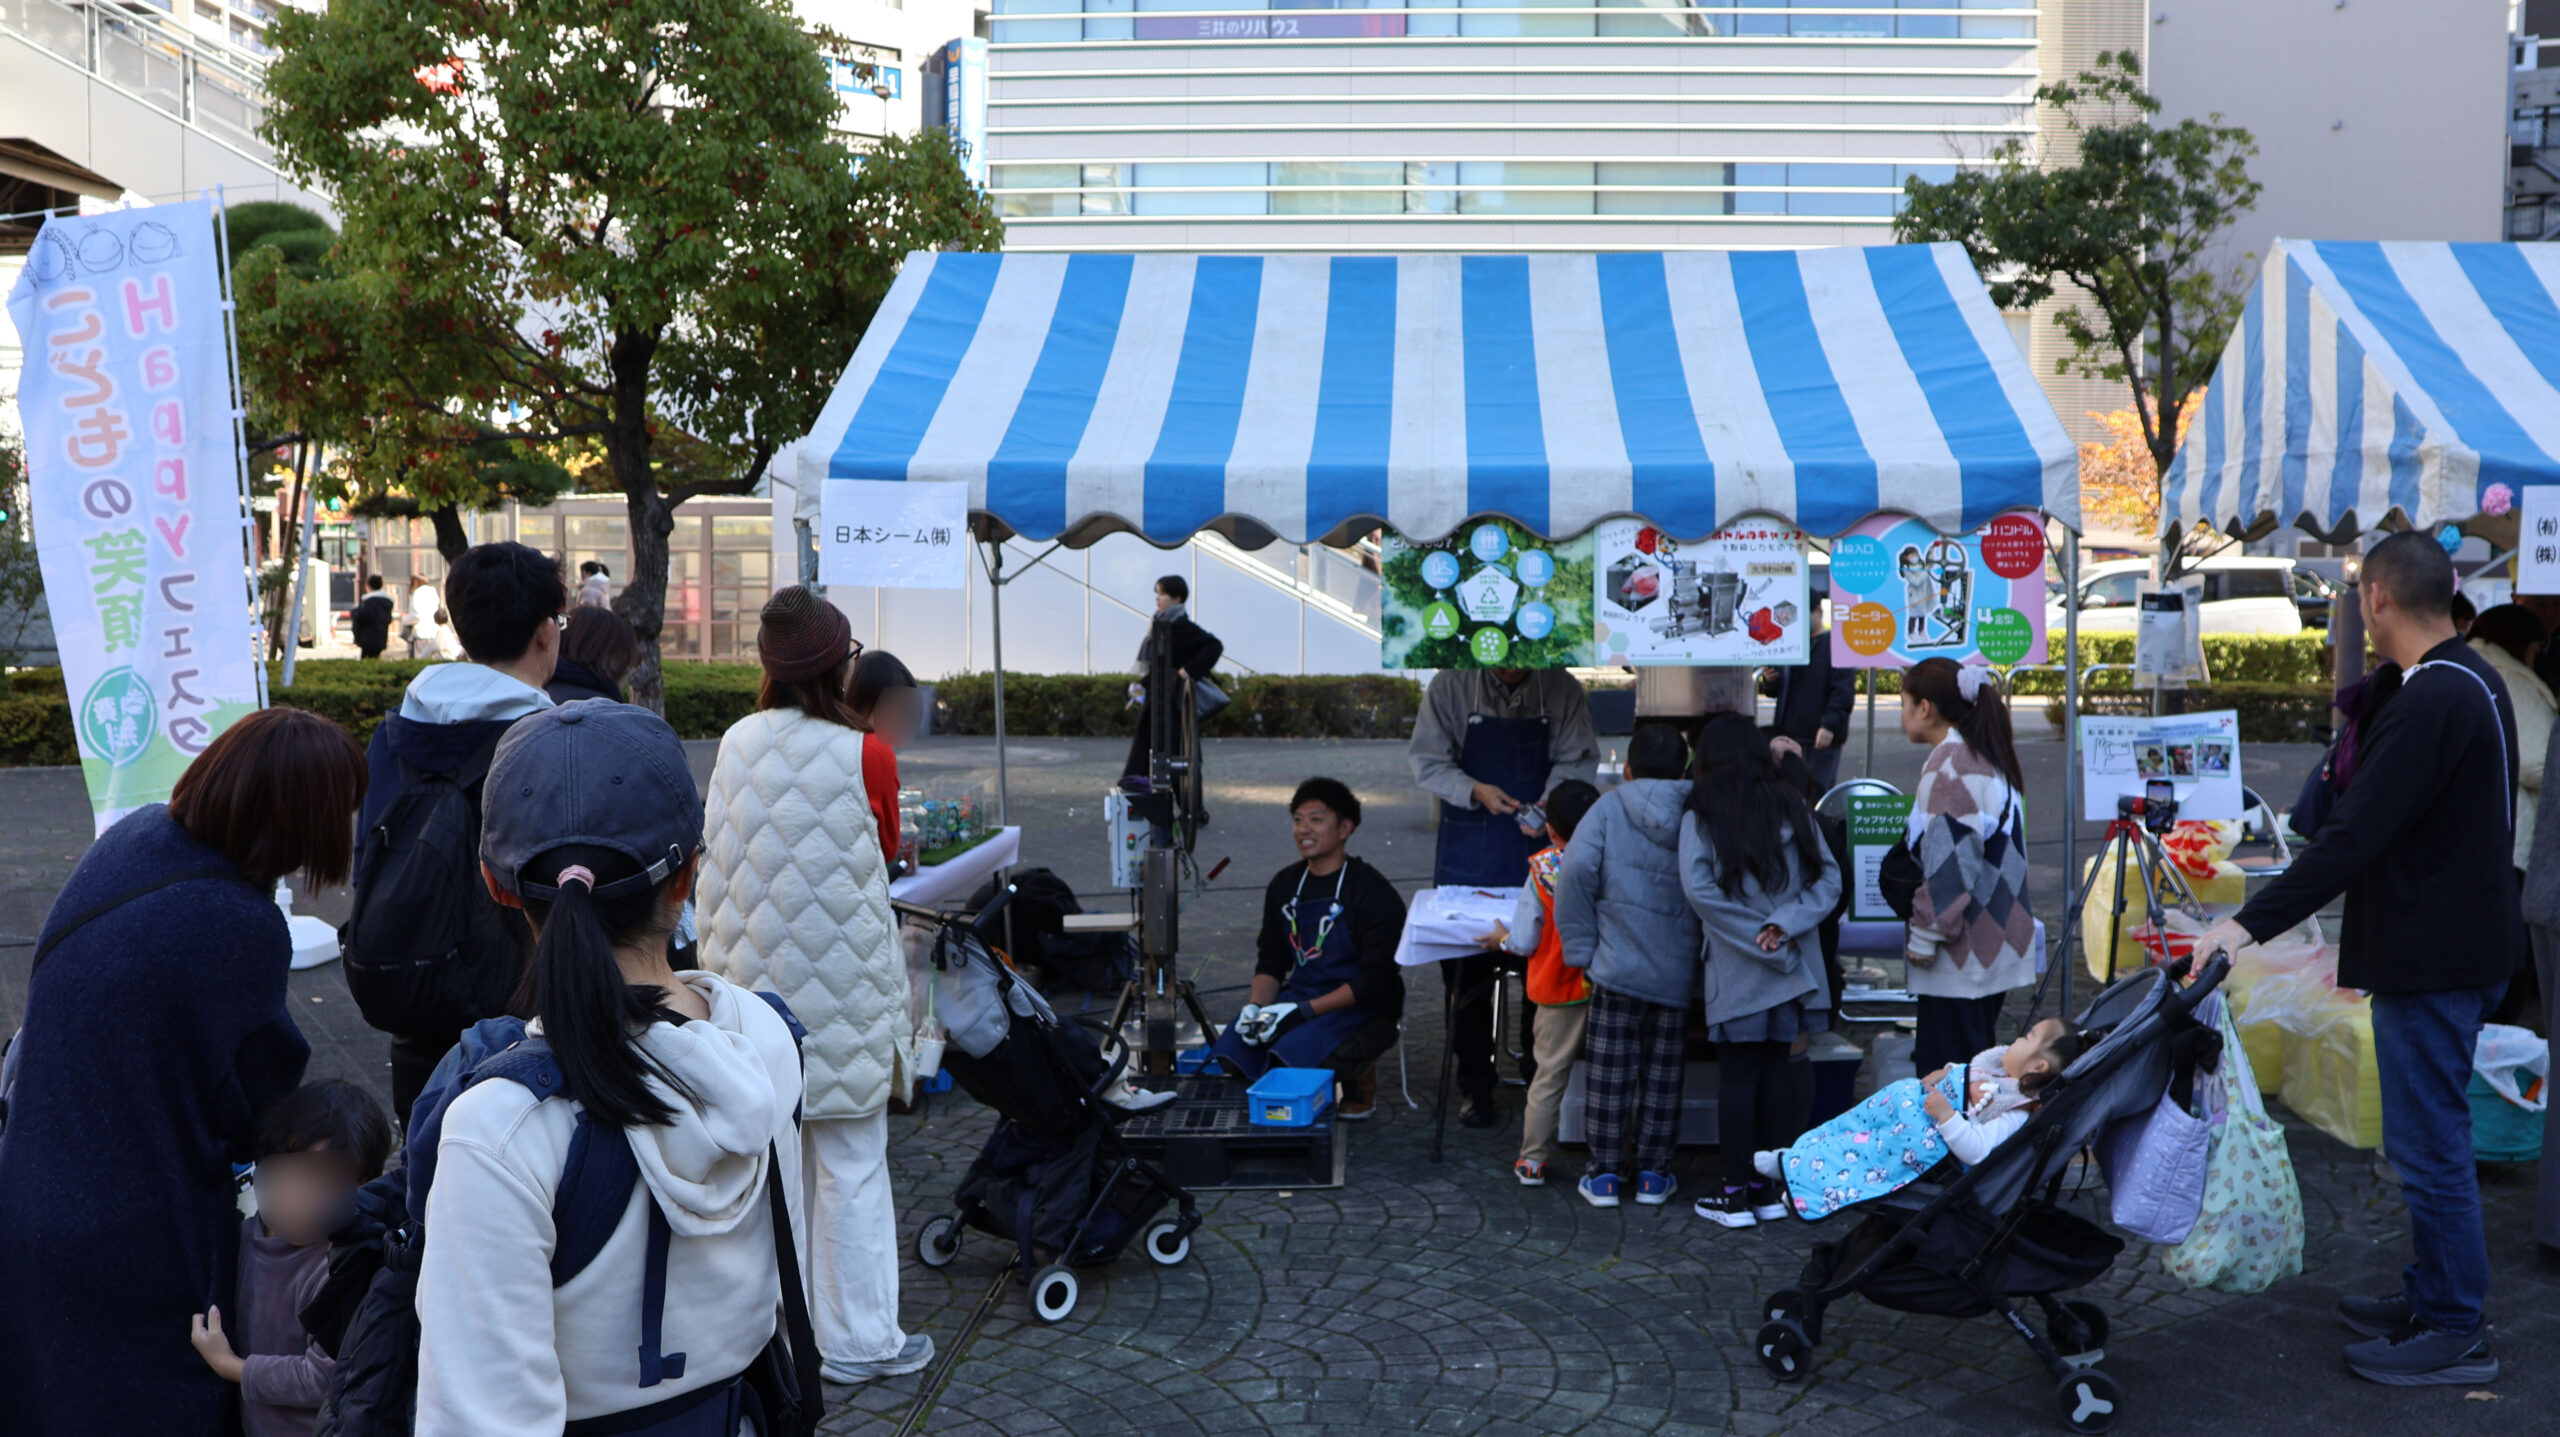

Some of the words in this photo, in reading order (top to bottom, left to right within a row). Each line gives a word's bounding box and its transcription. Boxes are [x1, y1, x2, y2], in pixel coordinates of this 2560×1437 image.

[1197, 19, 1300, 36] 三井のリハウス
[1993, 524, 2034, 536] ハンドル
[1833, 604, 1850, 621] 2
[1851, 610, 1890, 621] ヒーター
[1977, 607, 1993, 624] 4
